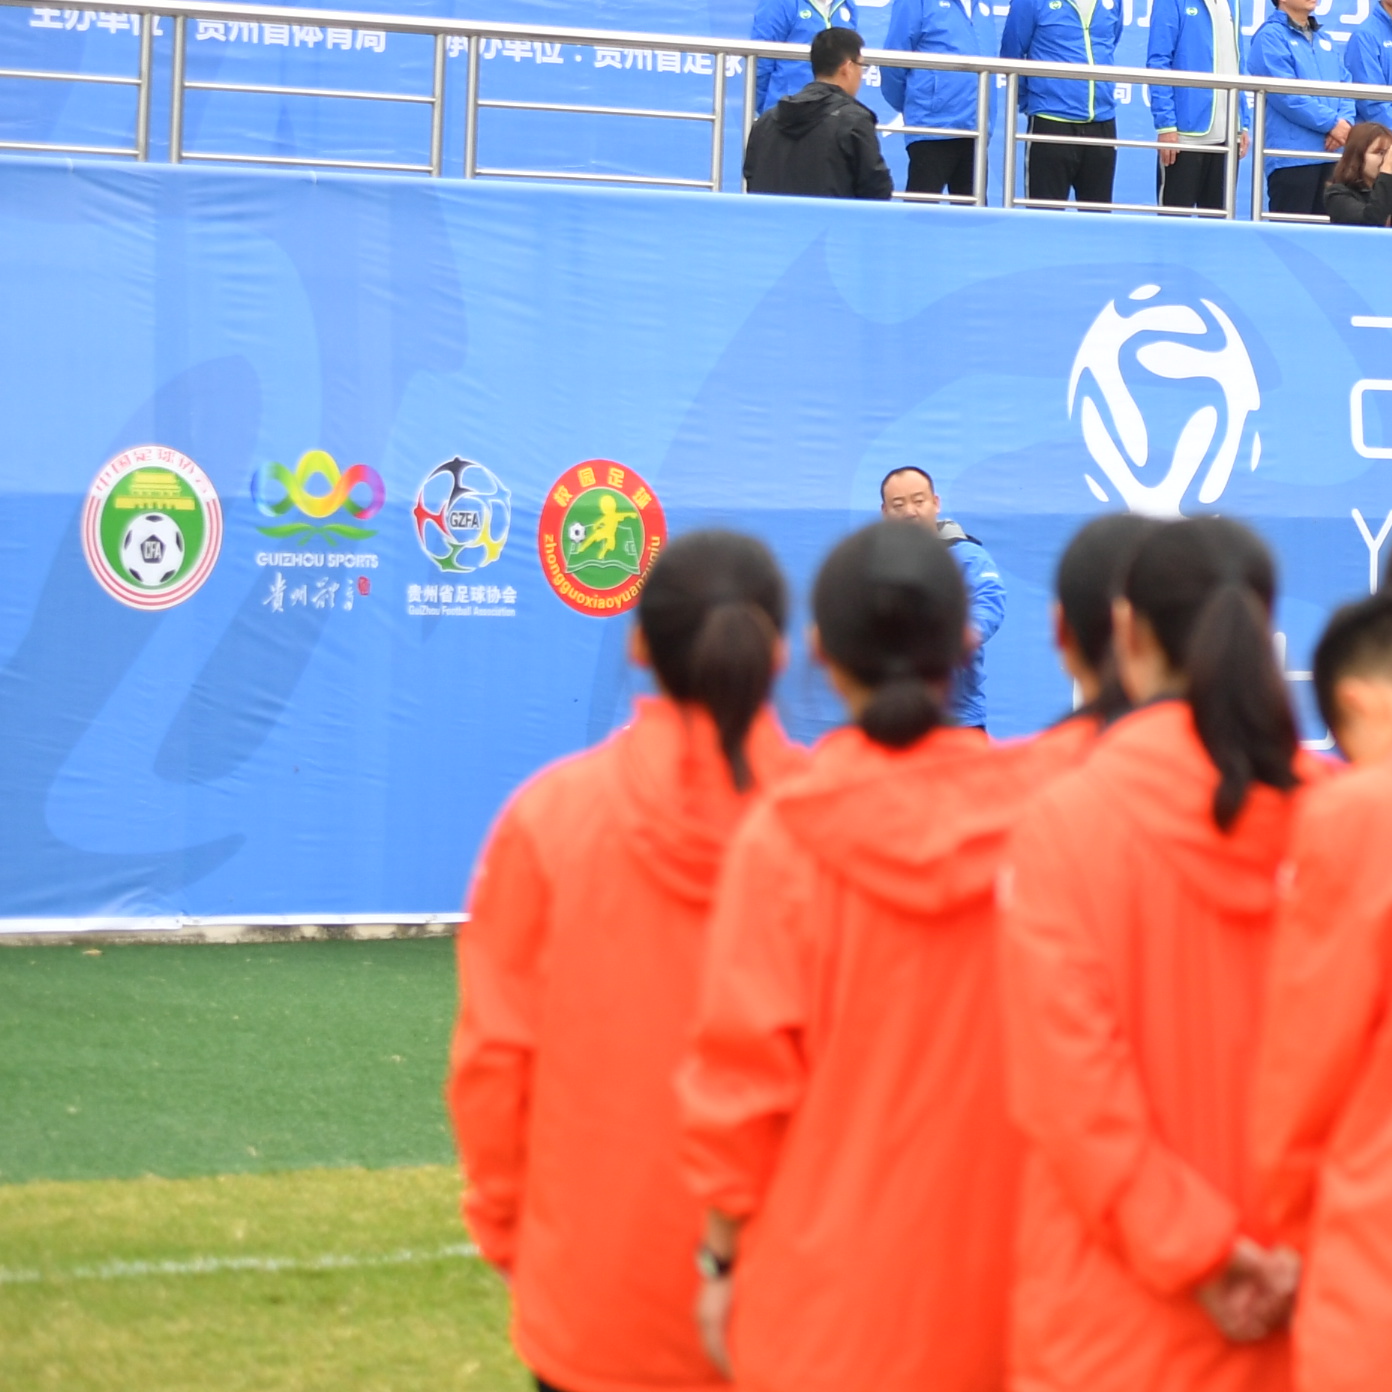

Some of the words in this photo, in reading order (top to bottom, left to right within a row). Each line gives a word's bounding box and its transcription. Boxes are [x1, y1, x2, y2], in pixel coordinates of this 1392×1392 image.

[451, 512, 480, 528] GZFA
[256, 552, 325, 567] GUIZHOU
[327, 554, 379, 568] SPORTS
[408, 584, 517, 604] 贵州省足球协会
